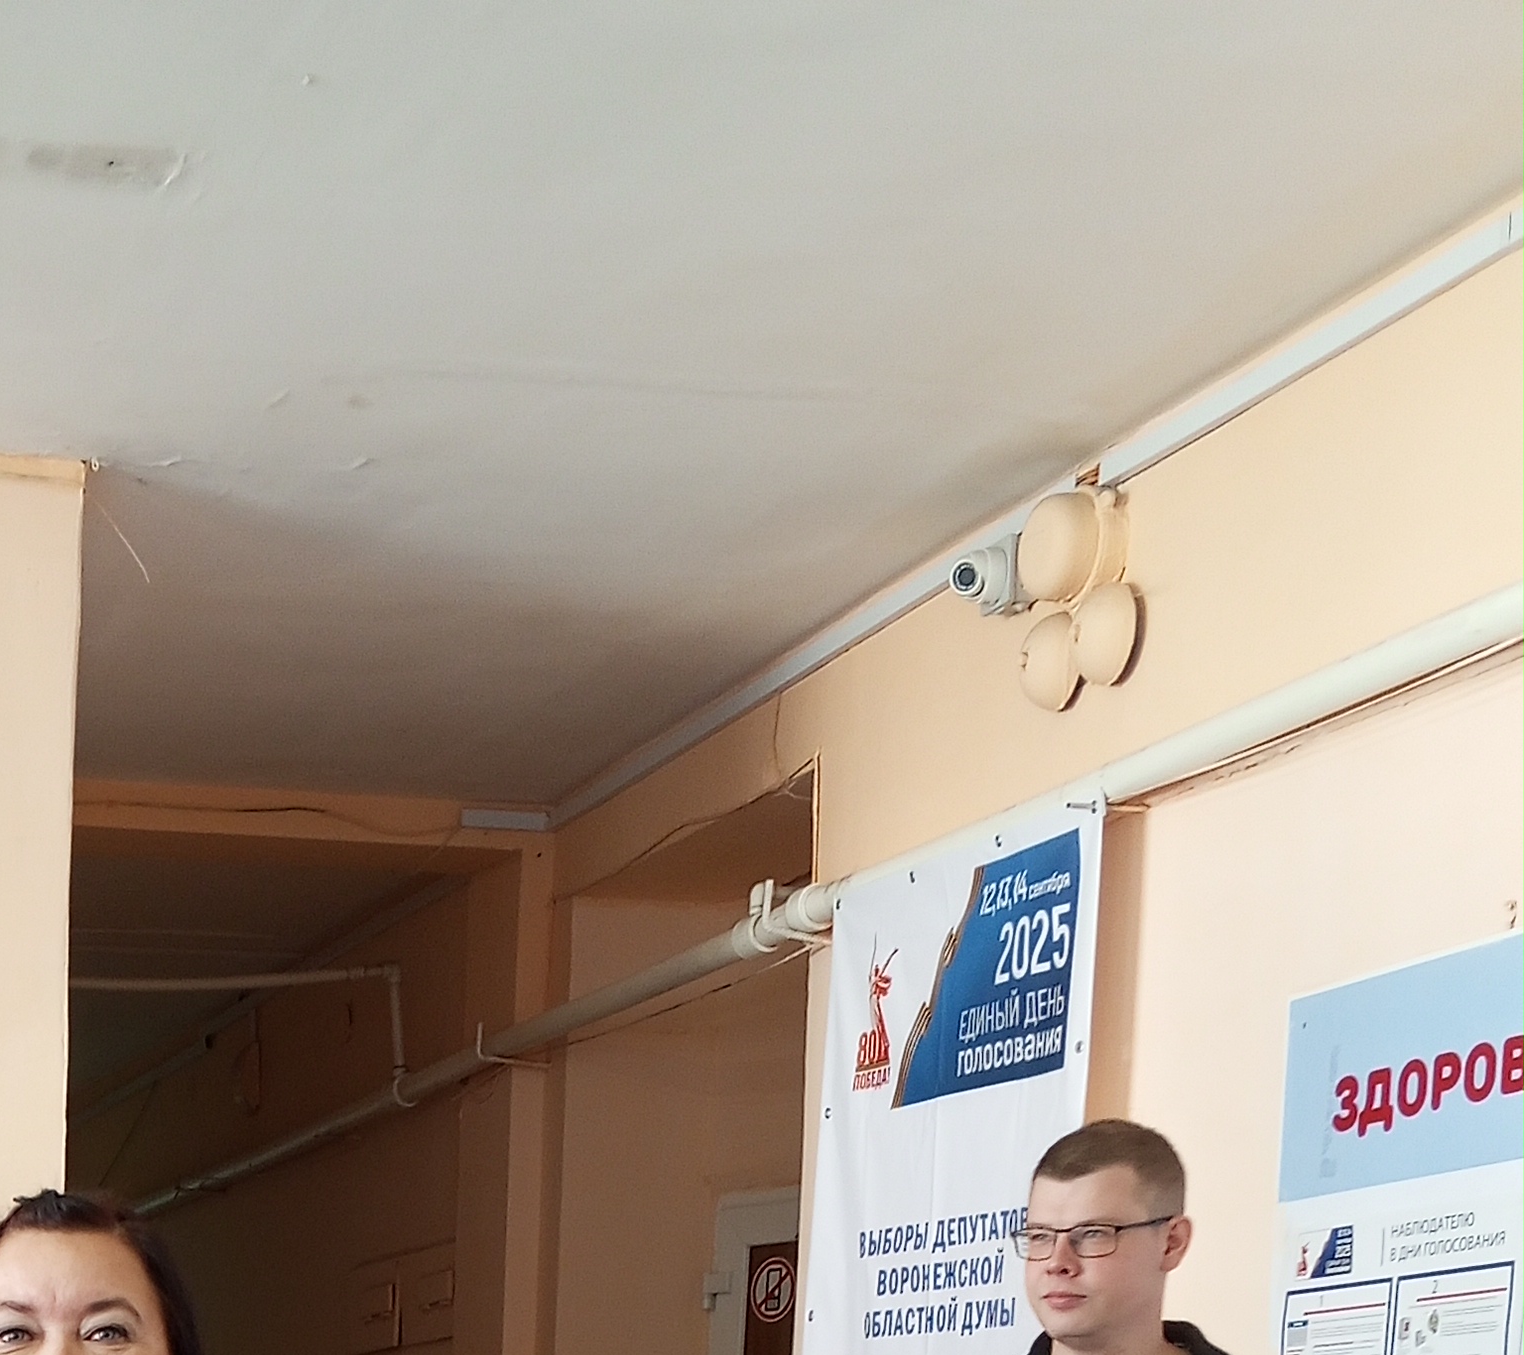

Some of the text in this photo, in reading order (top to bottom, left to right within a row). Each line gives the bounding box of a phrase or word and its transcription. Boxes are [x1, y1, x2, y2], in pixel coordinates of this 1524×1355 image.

[994, 902, 1071, 986] 2025
[958, 984, 1065, 1043] ЕДИНЫЙ ДЕНЬ
[1332, 1034, 1524, 1139] ЗДОРОВ
[859, 1222, 929, 1259] ВЫБОРЫ
[876, 1247, 1005, 1297] ВОРОНЕЖСКОЙ
[864, 1296, 1016, 1339] ОБЛАСТНОЙ ДУМЫ
